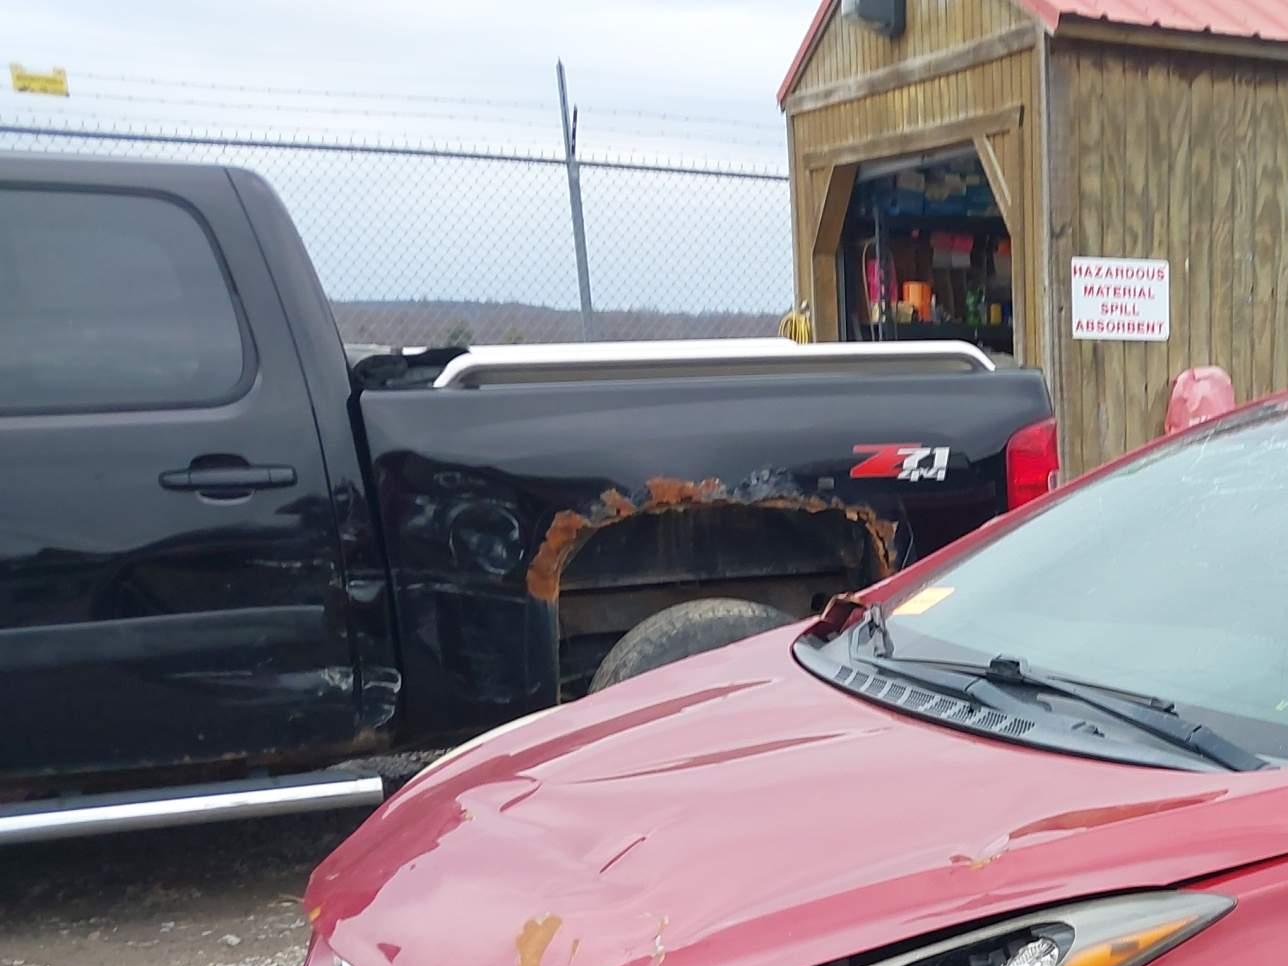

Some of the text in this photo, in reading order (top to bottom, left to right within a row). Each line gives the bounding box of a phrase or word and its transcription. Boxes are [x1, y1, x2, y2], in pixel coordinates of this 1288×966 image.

[1072, 263, 1165, 281] HAZARDOUS
[1083, 283, 1156, 300] MATERIAL
[1101, 301, 1140, 316] SPILL
[1075, 319, 1165, 335] ABSORBENT
